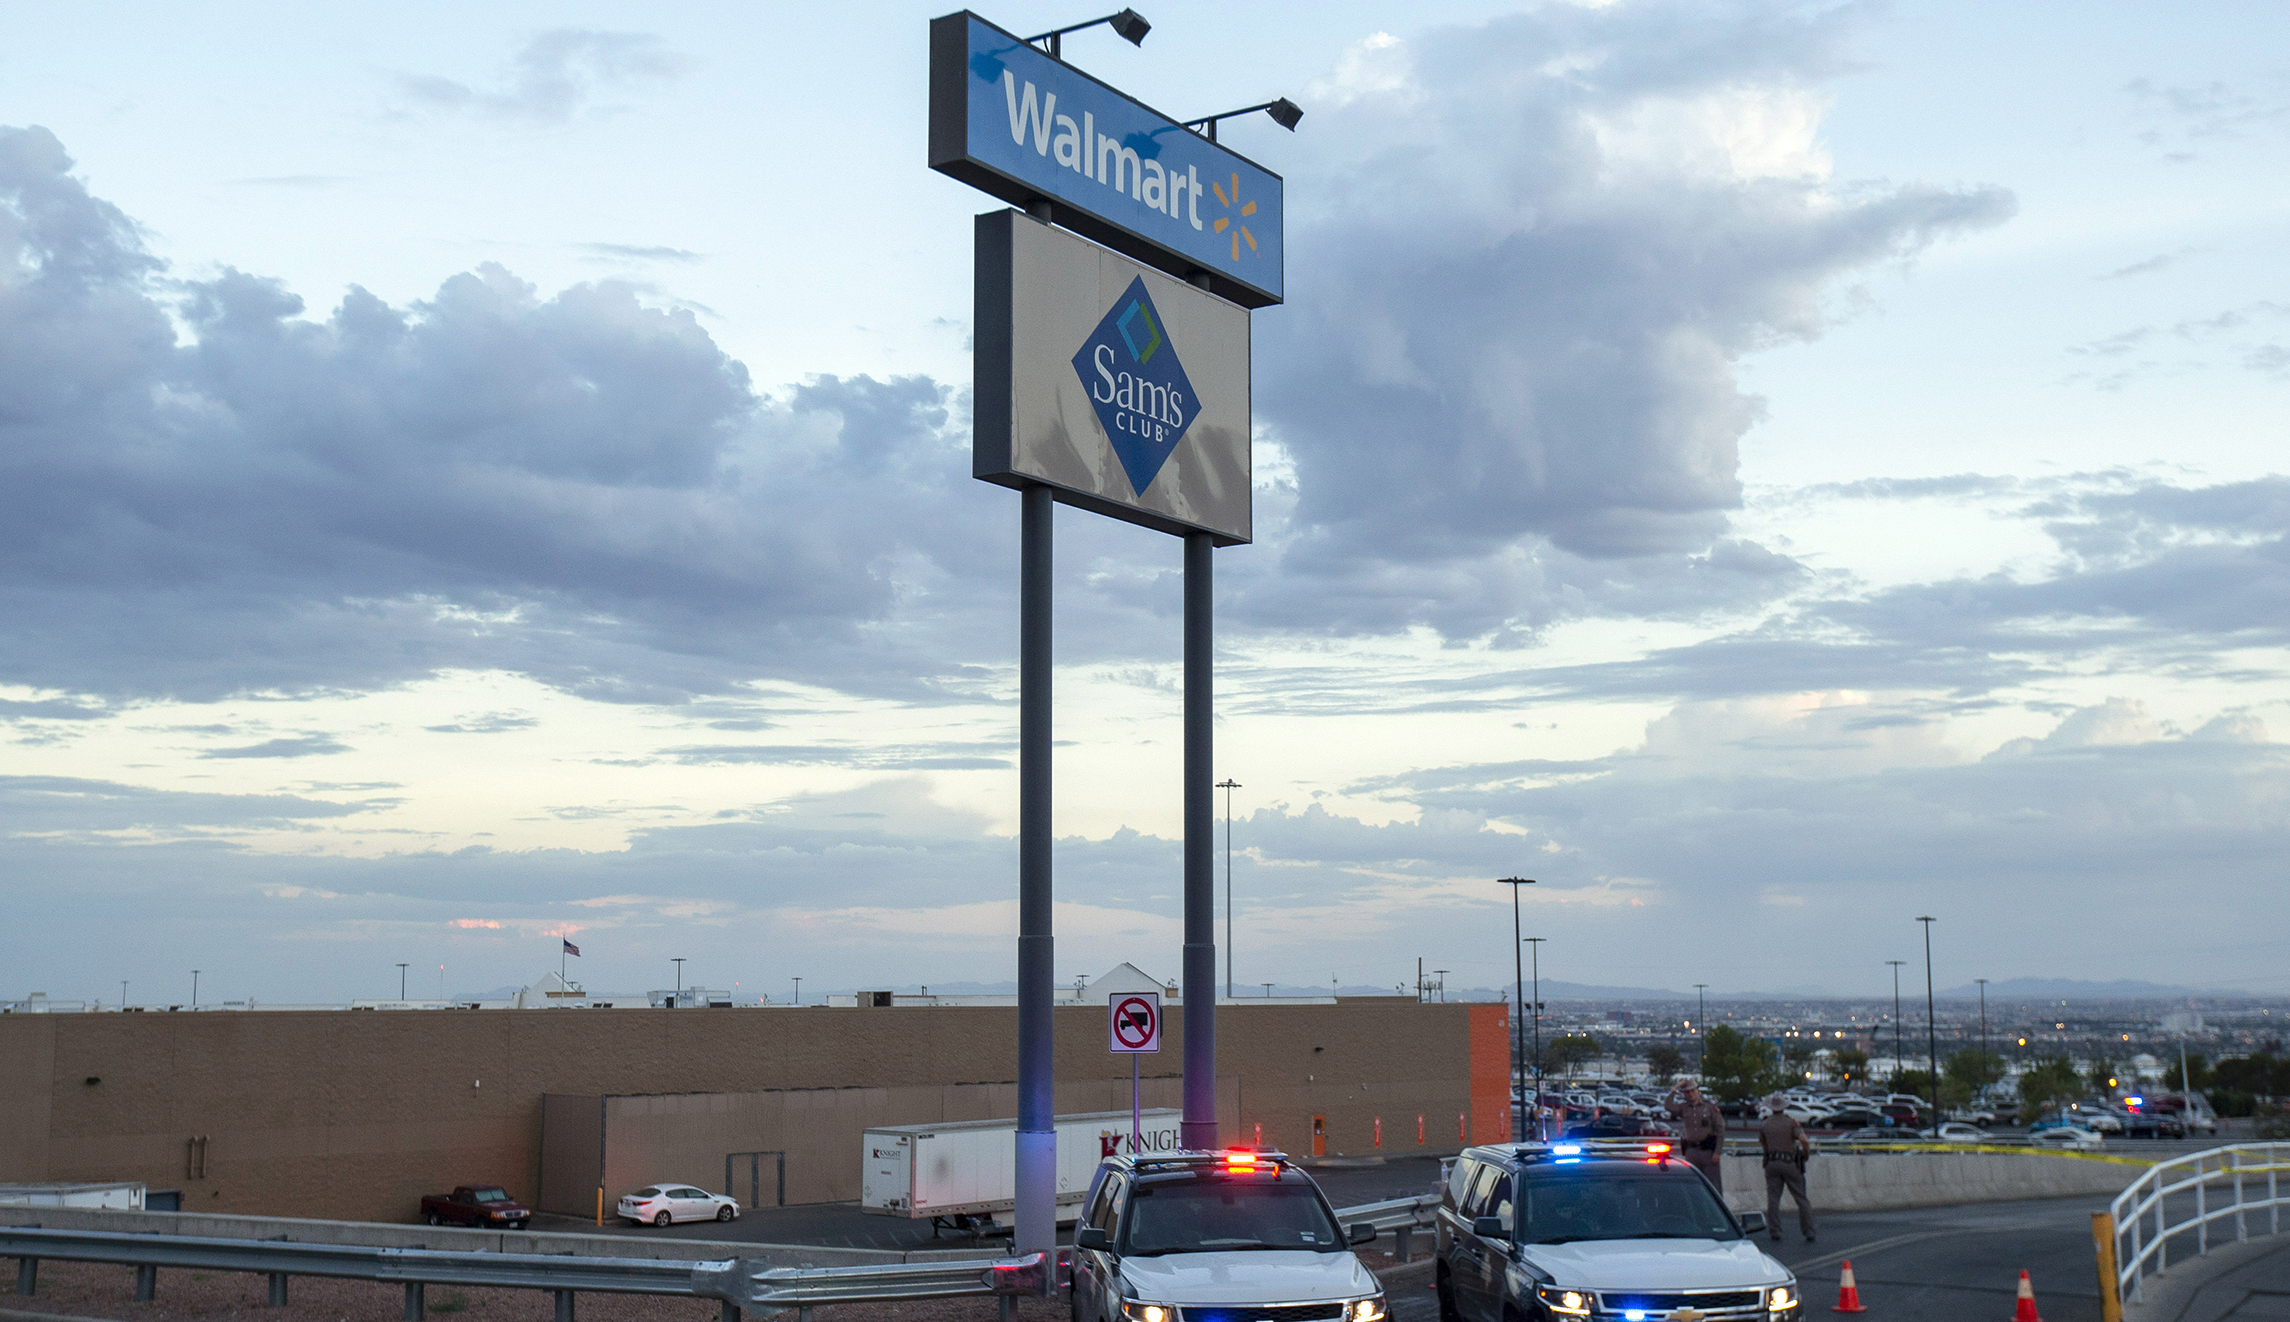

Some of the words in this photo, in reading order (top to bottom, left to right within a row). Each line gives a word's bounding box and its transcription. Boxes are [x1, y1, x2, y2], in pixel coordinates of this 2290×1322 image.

[1003, 69, 1203, 231] Walmart
[1093, 343, 1183, 429] Sam's
[1116, 411, 1164, 443] CLUB
[1126, 1129, 1182, 1153] KNIGH
